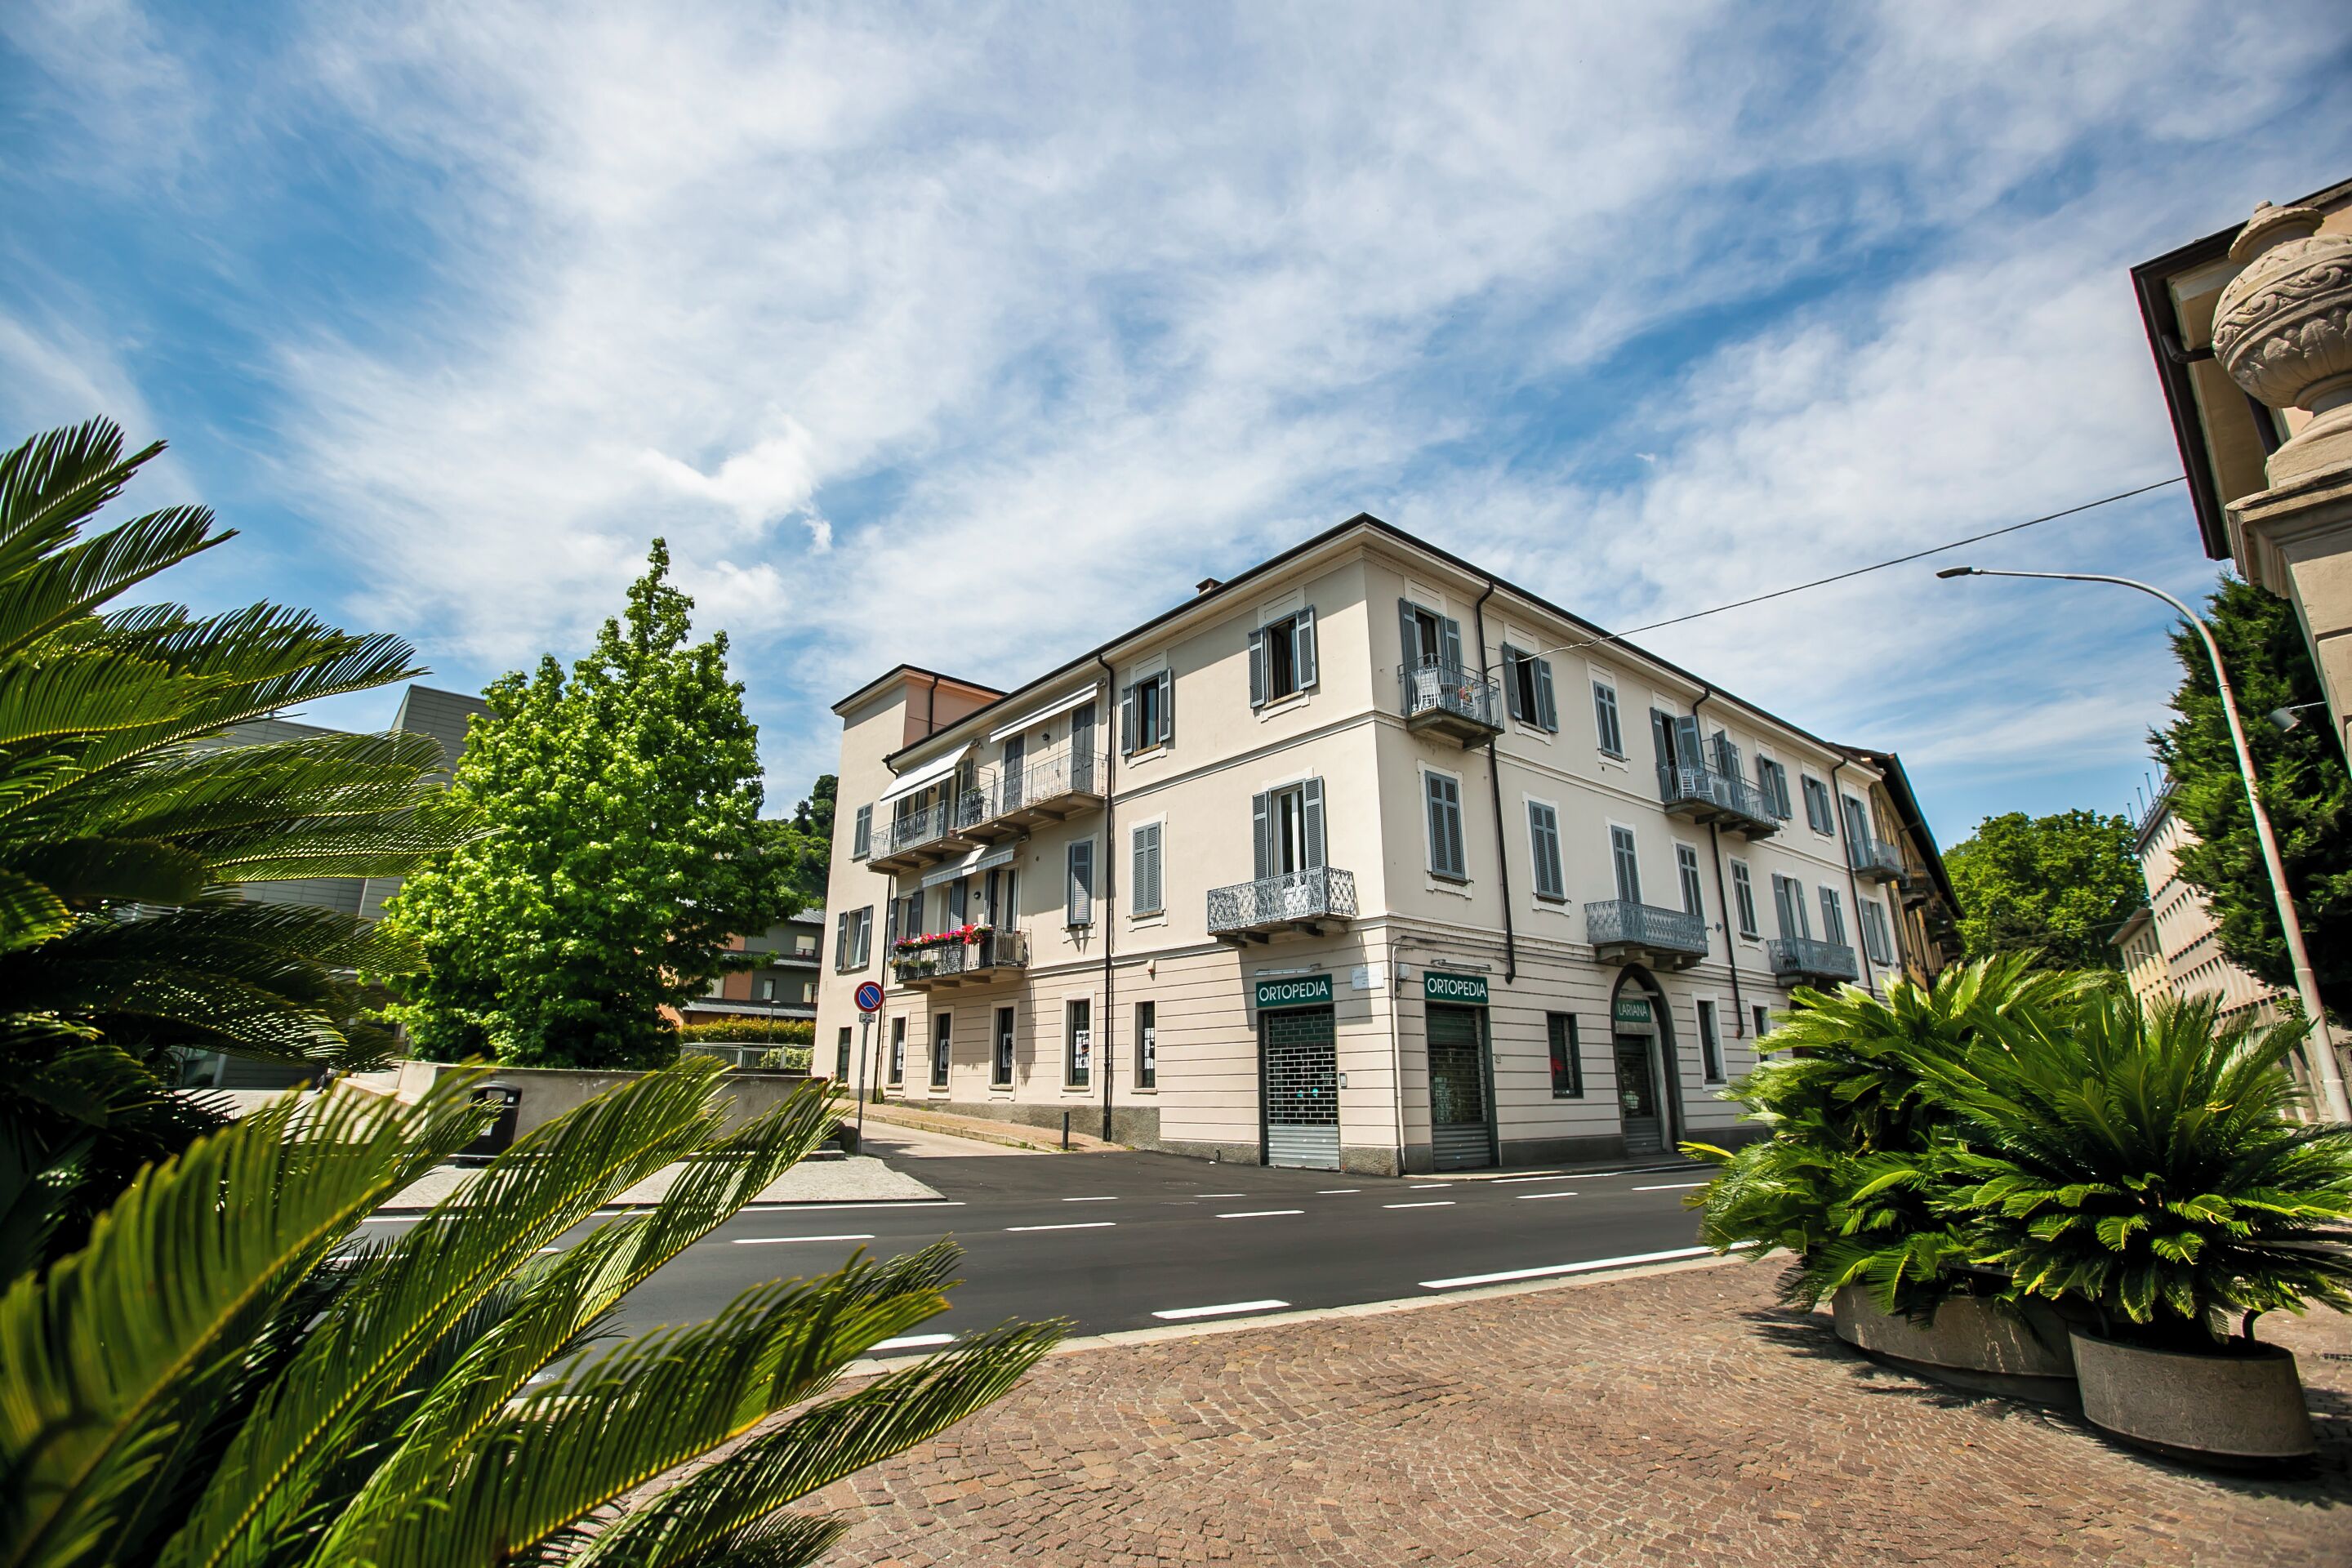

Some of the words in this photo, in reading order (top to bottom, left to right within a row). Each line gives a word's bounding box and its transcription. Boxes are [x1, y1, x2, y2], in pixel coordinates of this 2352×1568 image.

[1258, 981, 1328, 1001] ORTOPEDIA
[1428, 978, 1486, 997] ORTOPEDIA
[1618, 1004, 1648, 1018] LARIANA
